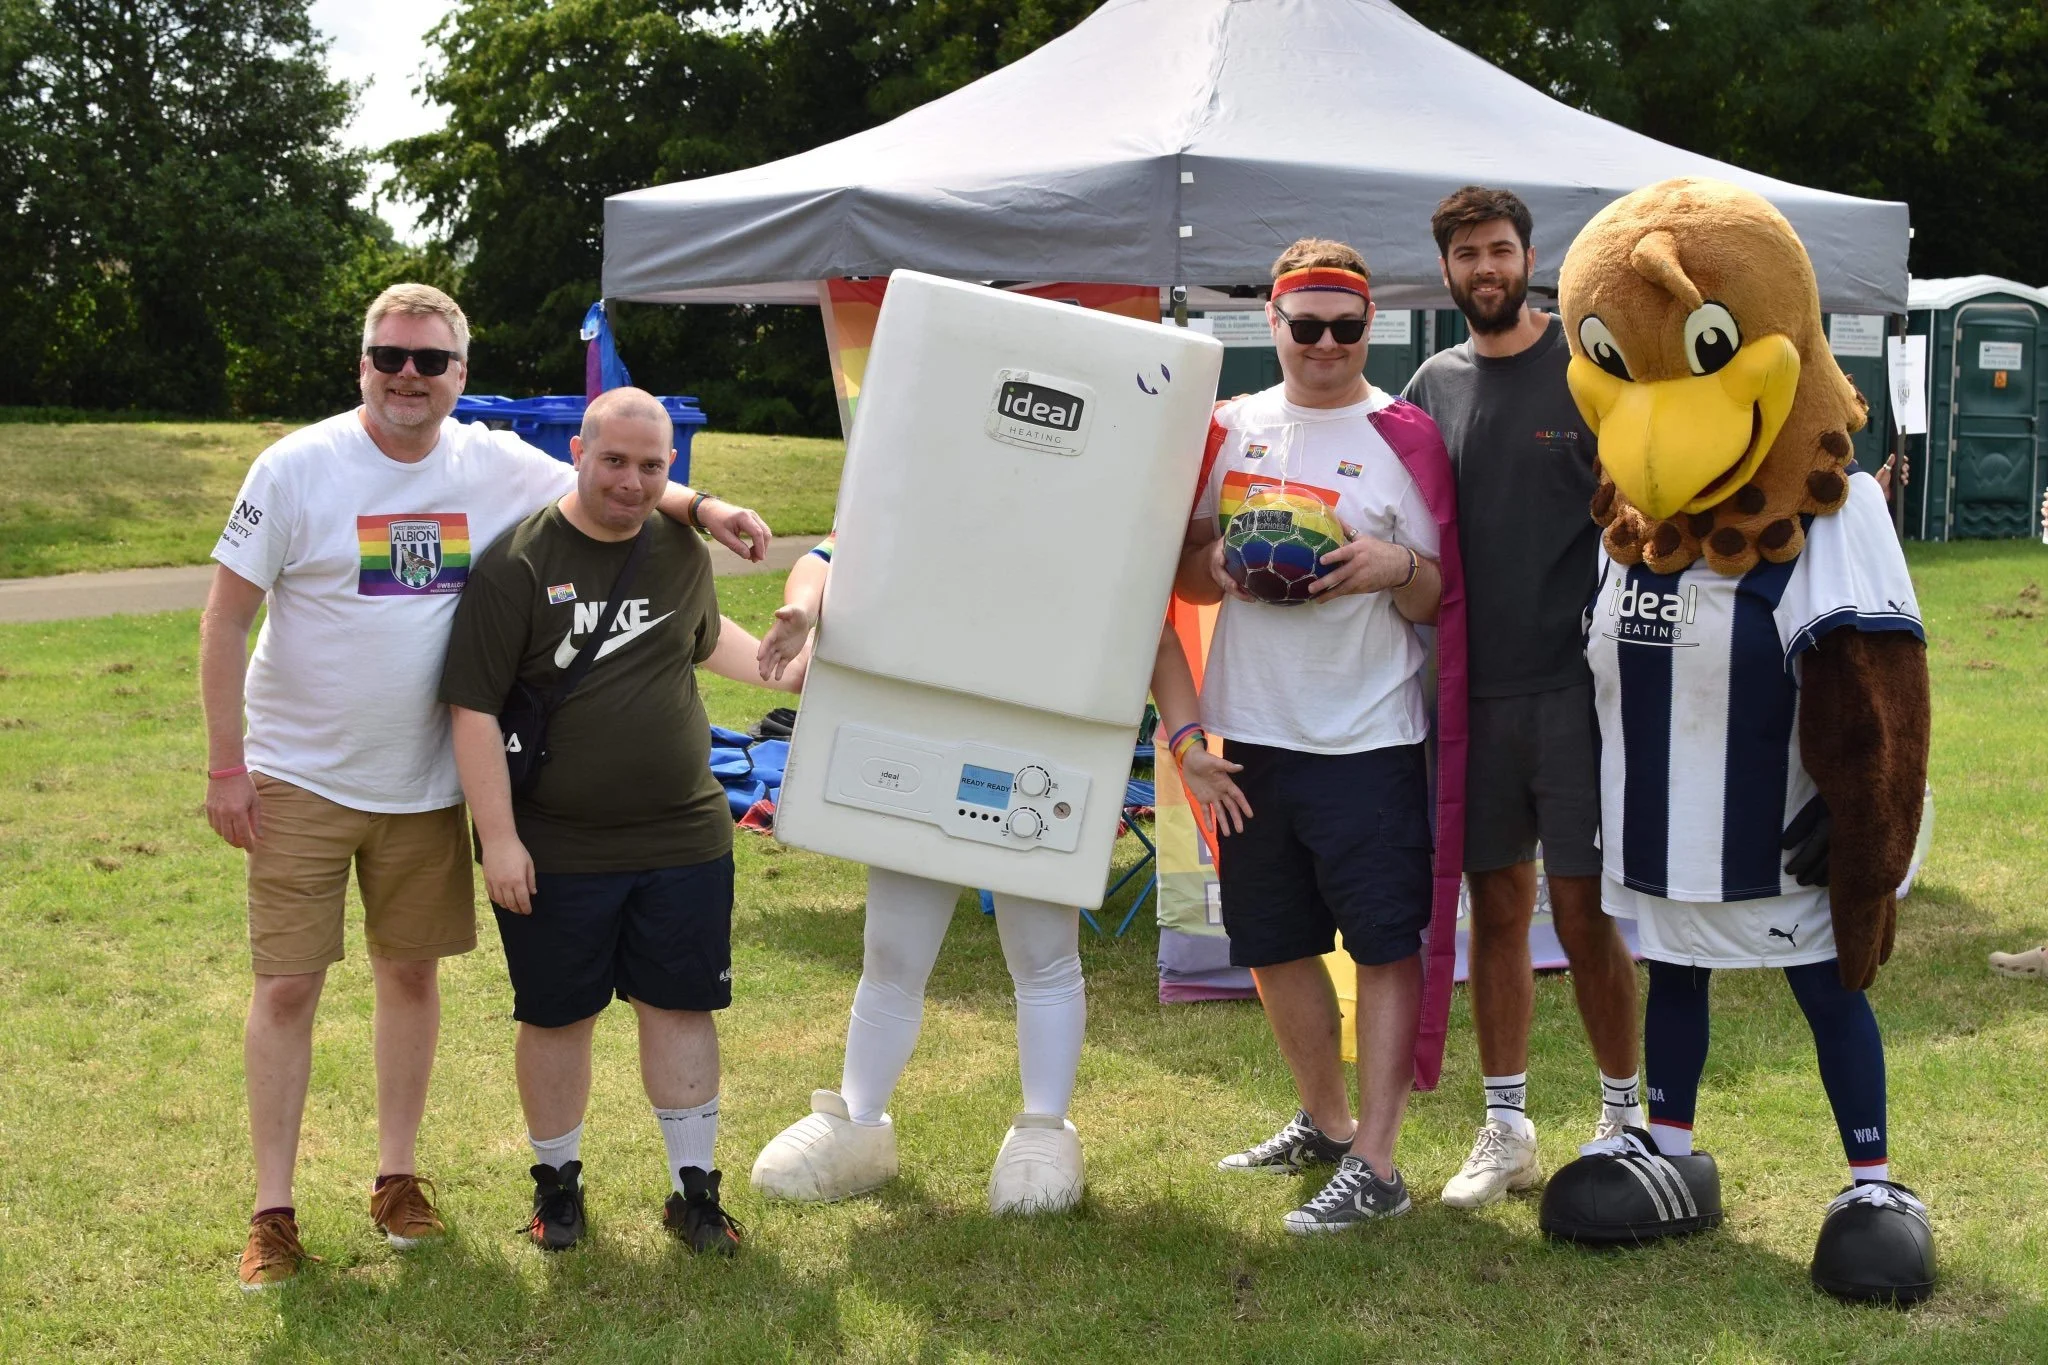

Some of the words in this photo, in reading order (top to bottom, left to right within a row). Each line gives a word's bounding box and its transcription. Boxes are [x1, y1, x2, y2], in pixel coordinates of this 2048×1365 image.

[1004, 387, 1078, 428] ideal
[1009, 426, 1062, 443] HEATING
[236, 500, 263, 525] NS
[393, 530, 437, 542] ALBION
[1608, 578, 1698, 625] ideal
[1614, 621, 1682, 639] HEATING
[881, 769, 900, 780] ideal
[961, 777, 985, 788] READY
[986, 782, 1011, 793] READY
[1853, 1126, 1880, 1144] WBA
